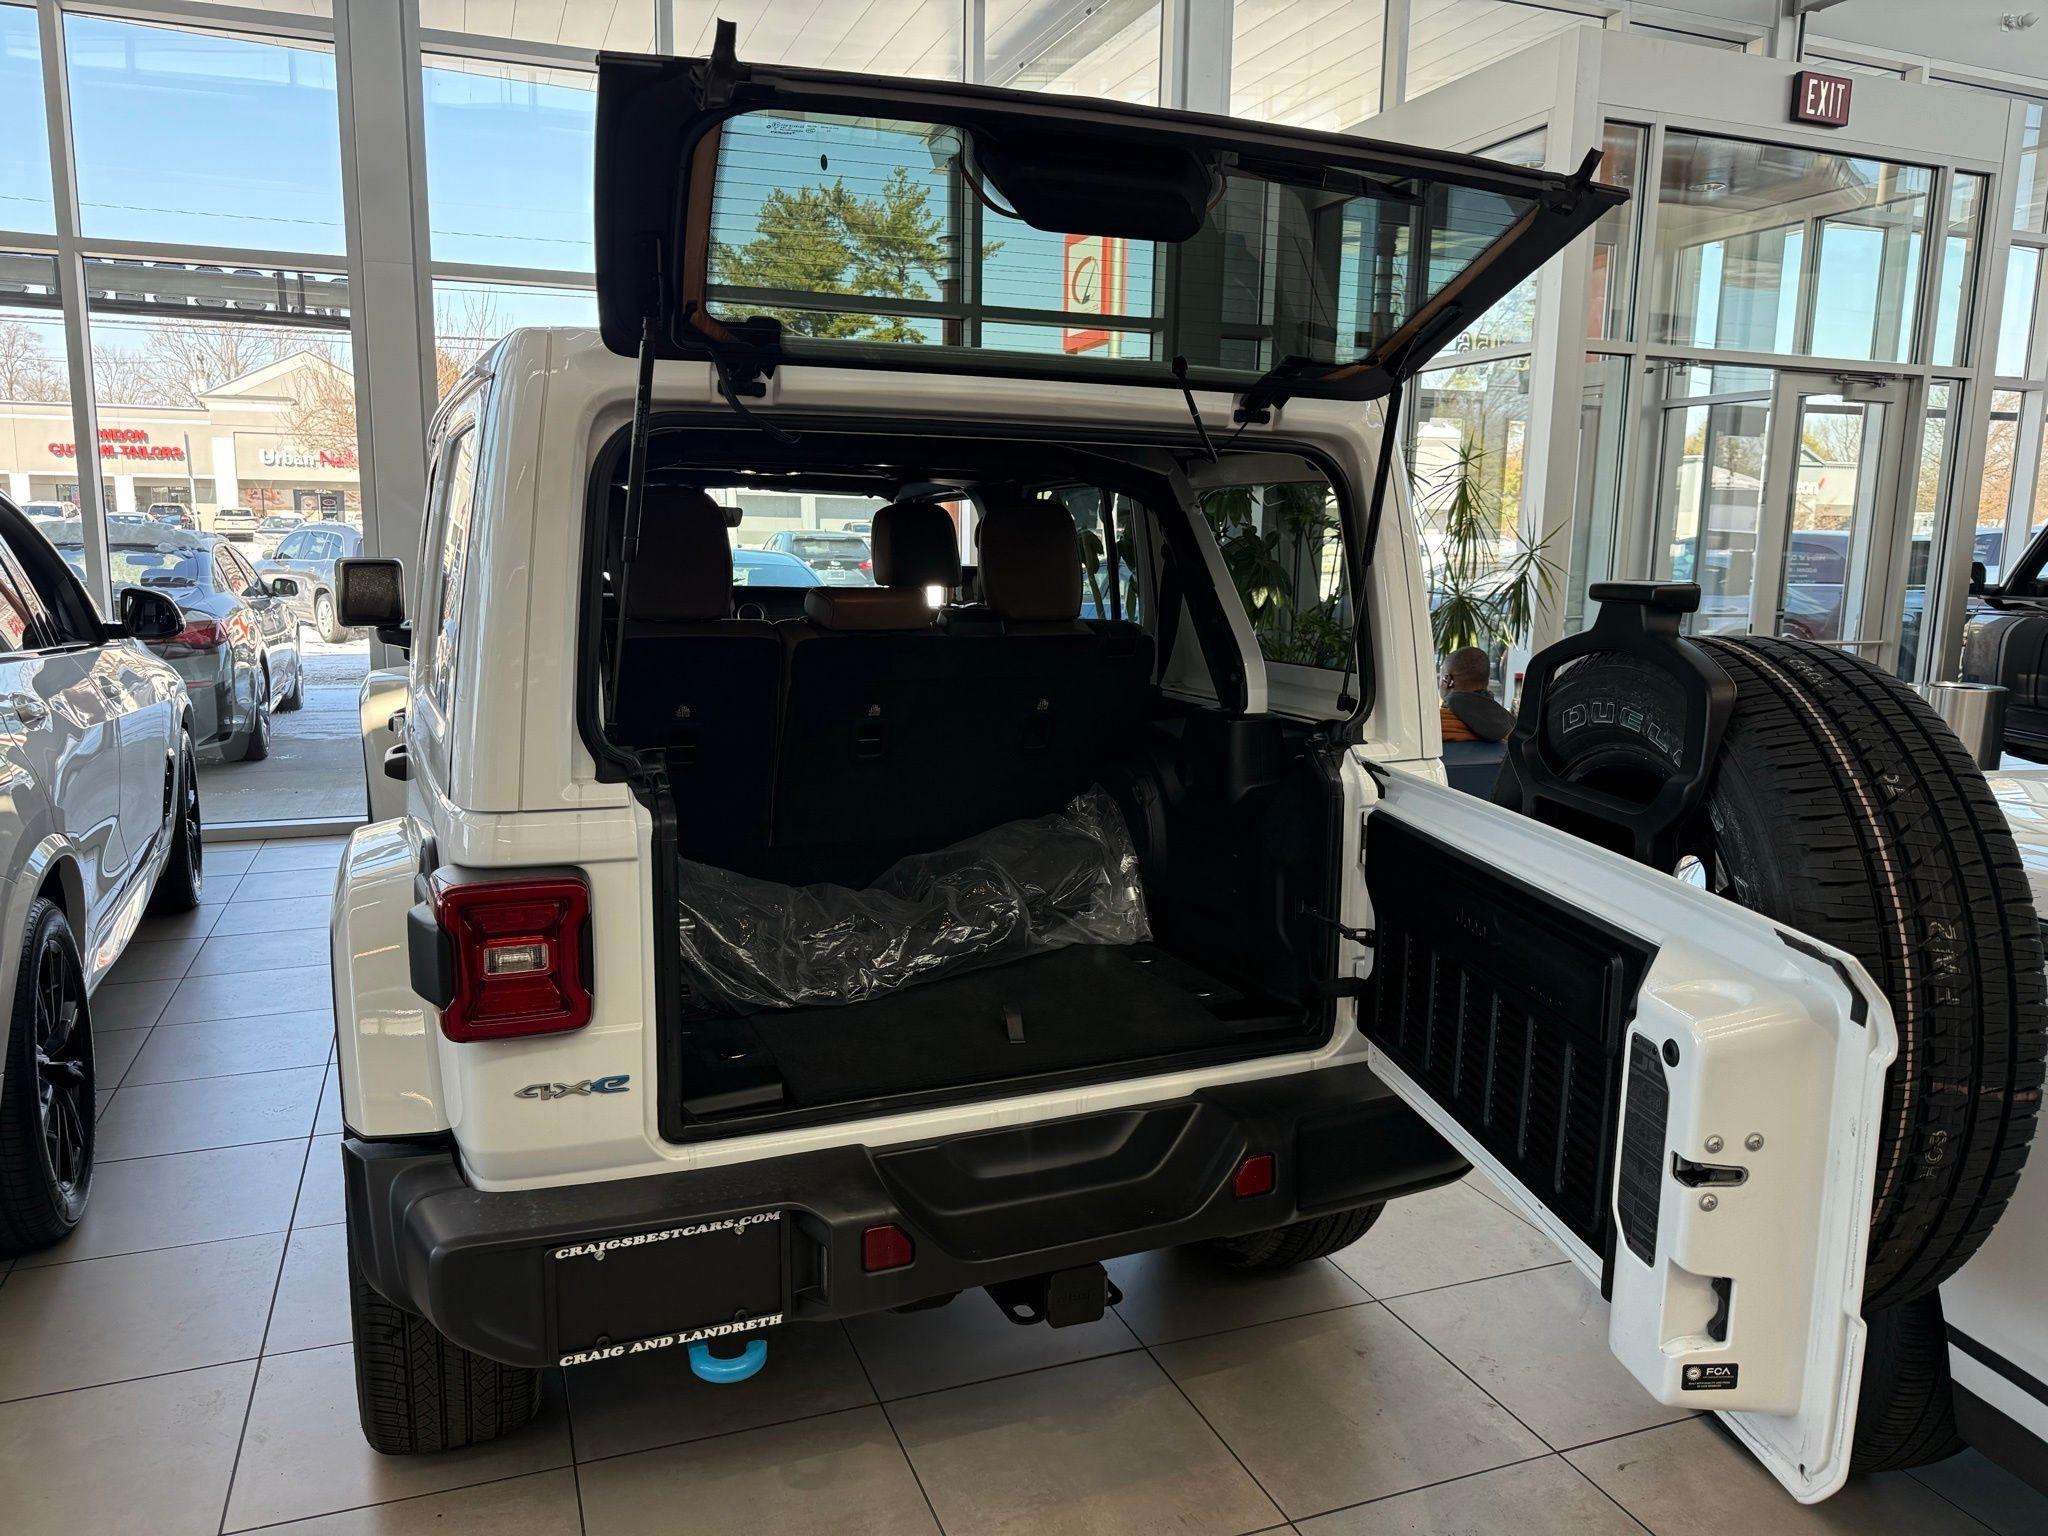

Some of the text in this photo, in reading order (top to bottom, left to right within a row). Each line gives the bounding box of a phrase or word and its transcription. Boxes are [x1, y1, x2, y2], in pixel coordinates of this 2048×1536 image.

[1806, 78, 1846, 119] EXIT
[97, 428, 147, 443] NDON
[119, 445, 184, 460] TAILORS
[259, 448, 317, 468] Urban
[555, 1210, 782, 1260] CRAIGSBESTCARS.COM
[559, 1315, 783, 1367] CRAIG AND LANDRETH
[1706, 1367, 1731, 1375] FCA
